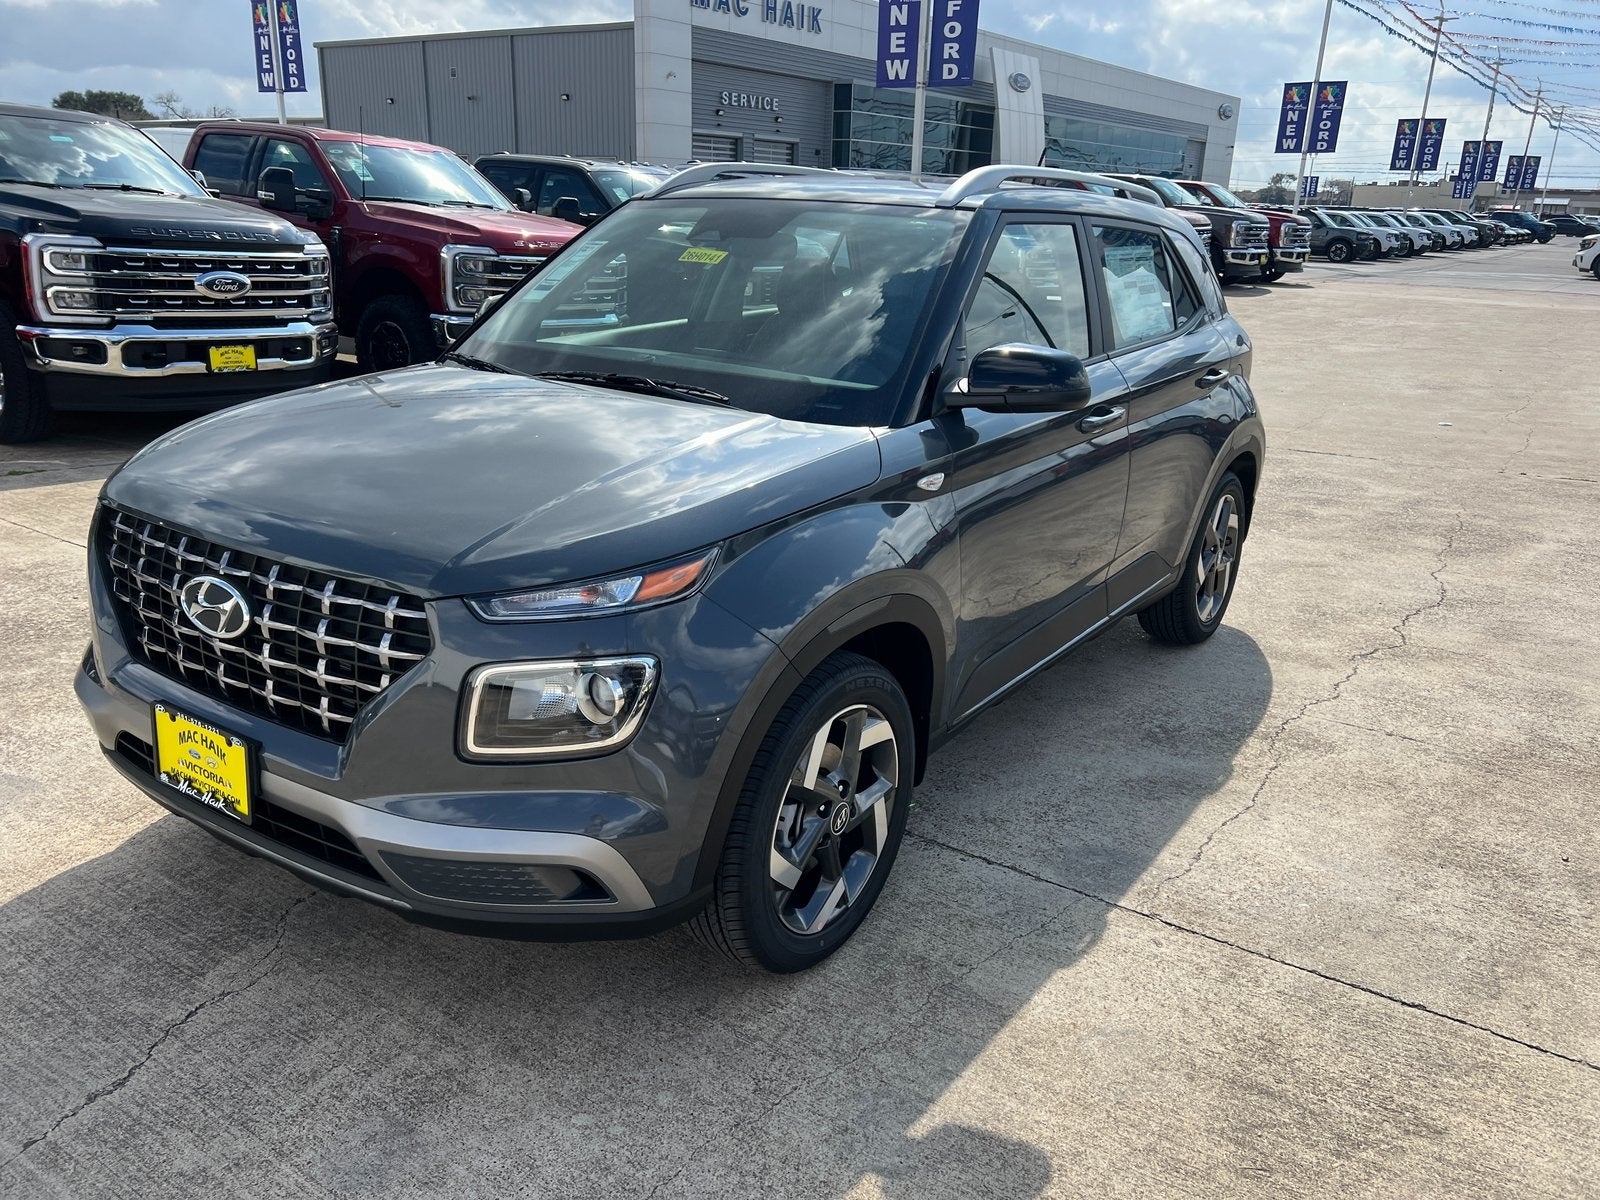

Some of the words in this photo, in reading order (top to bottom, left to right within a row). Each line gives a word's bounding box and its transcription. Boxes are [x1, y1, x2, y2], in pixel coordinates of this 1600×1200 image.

[765, 0, 822, 33] HAIK
[885, 4, 910, 81] NEW
[942, 0, 962, 80] FORD
[260, 35, 273, 87] NEW
[286, 34, 299, 88] FORD
[721, 91, 779, 111] SERVICE
[1282, 110, 1299, 150] NEW
[1316, 110, 1333, 150] FORD
[1395, 139, 1409, 168] NEW
[1421, 139, 1435, 169] FORD
[1461, 156, 1473, 180] NEW
[1483, 156, 1494, 180] FORD
[1506, 168, 1517, 188] NEW
[1523, 169, 1534, 189] FORD
[130, 227, 222, 241] SUPER
[224, 231, 281, 242] DUTY
[213, 278, 239, 292] Ford
[179, 730, 199, 745] MAC
[200, 733, 227, 766] HAIK
[184, 759, 226, 787] VICTORIA
